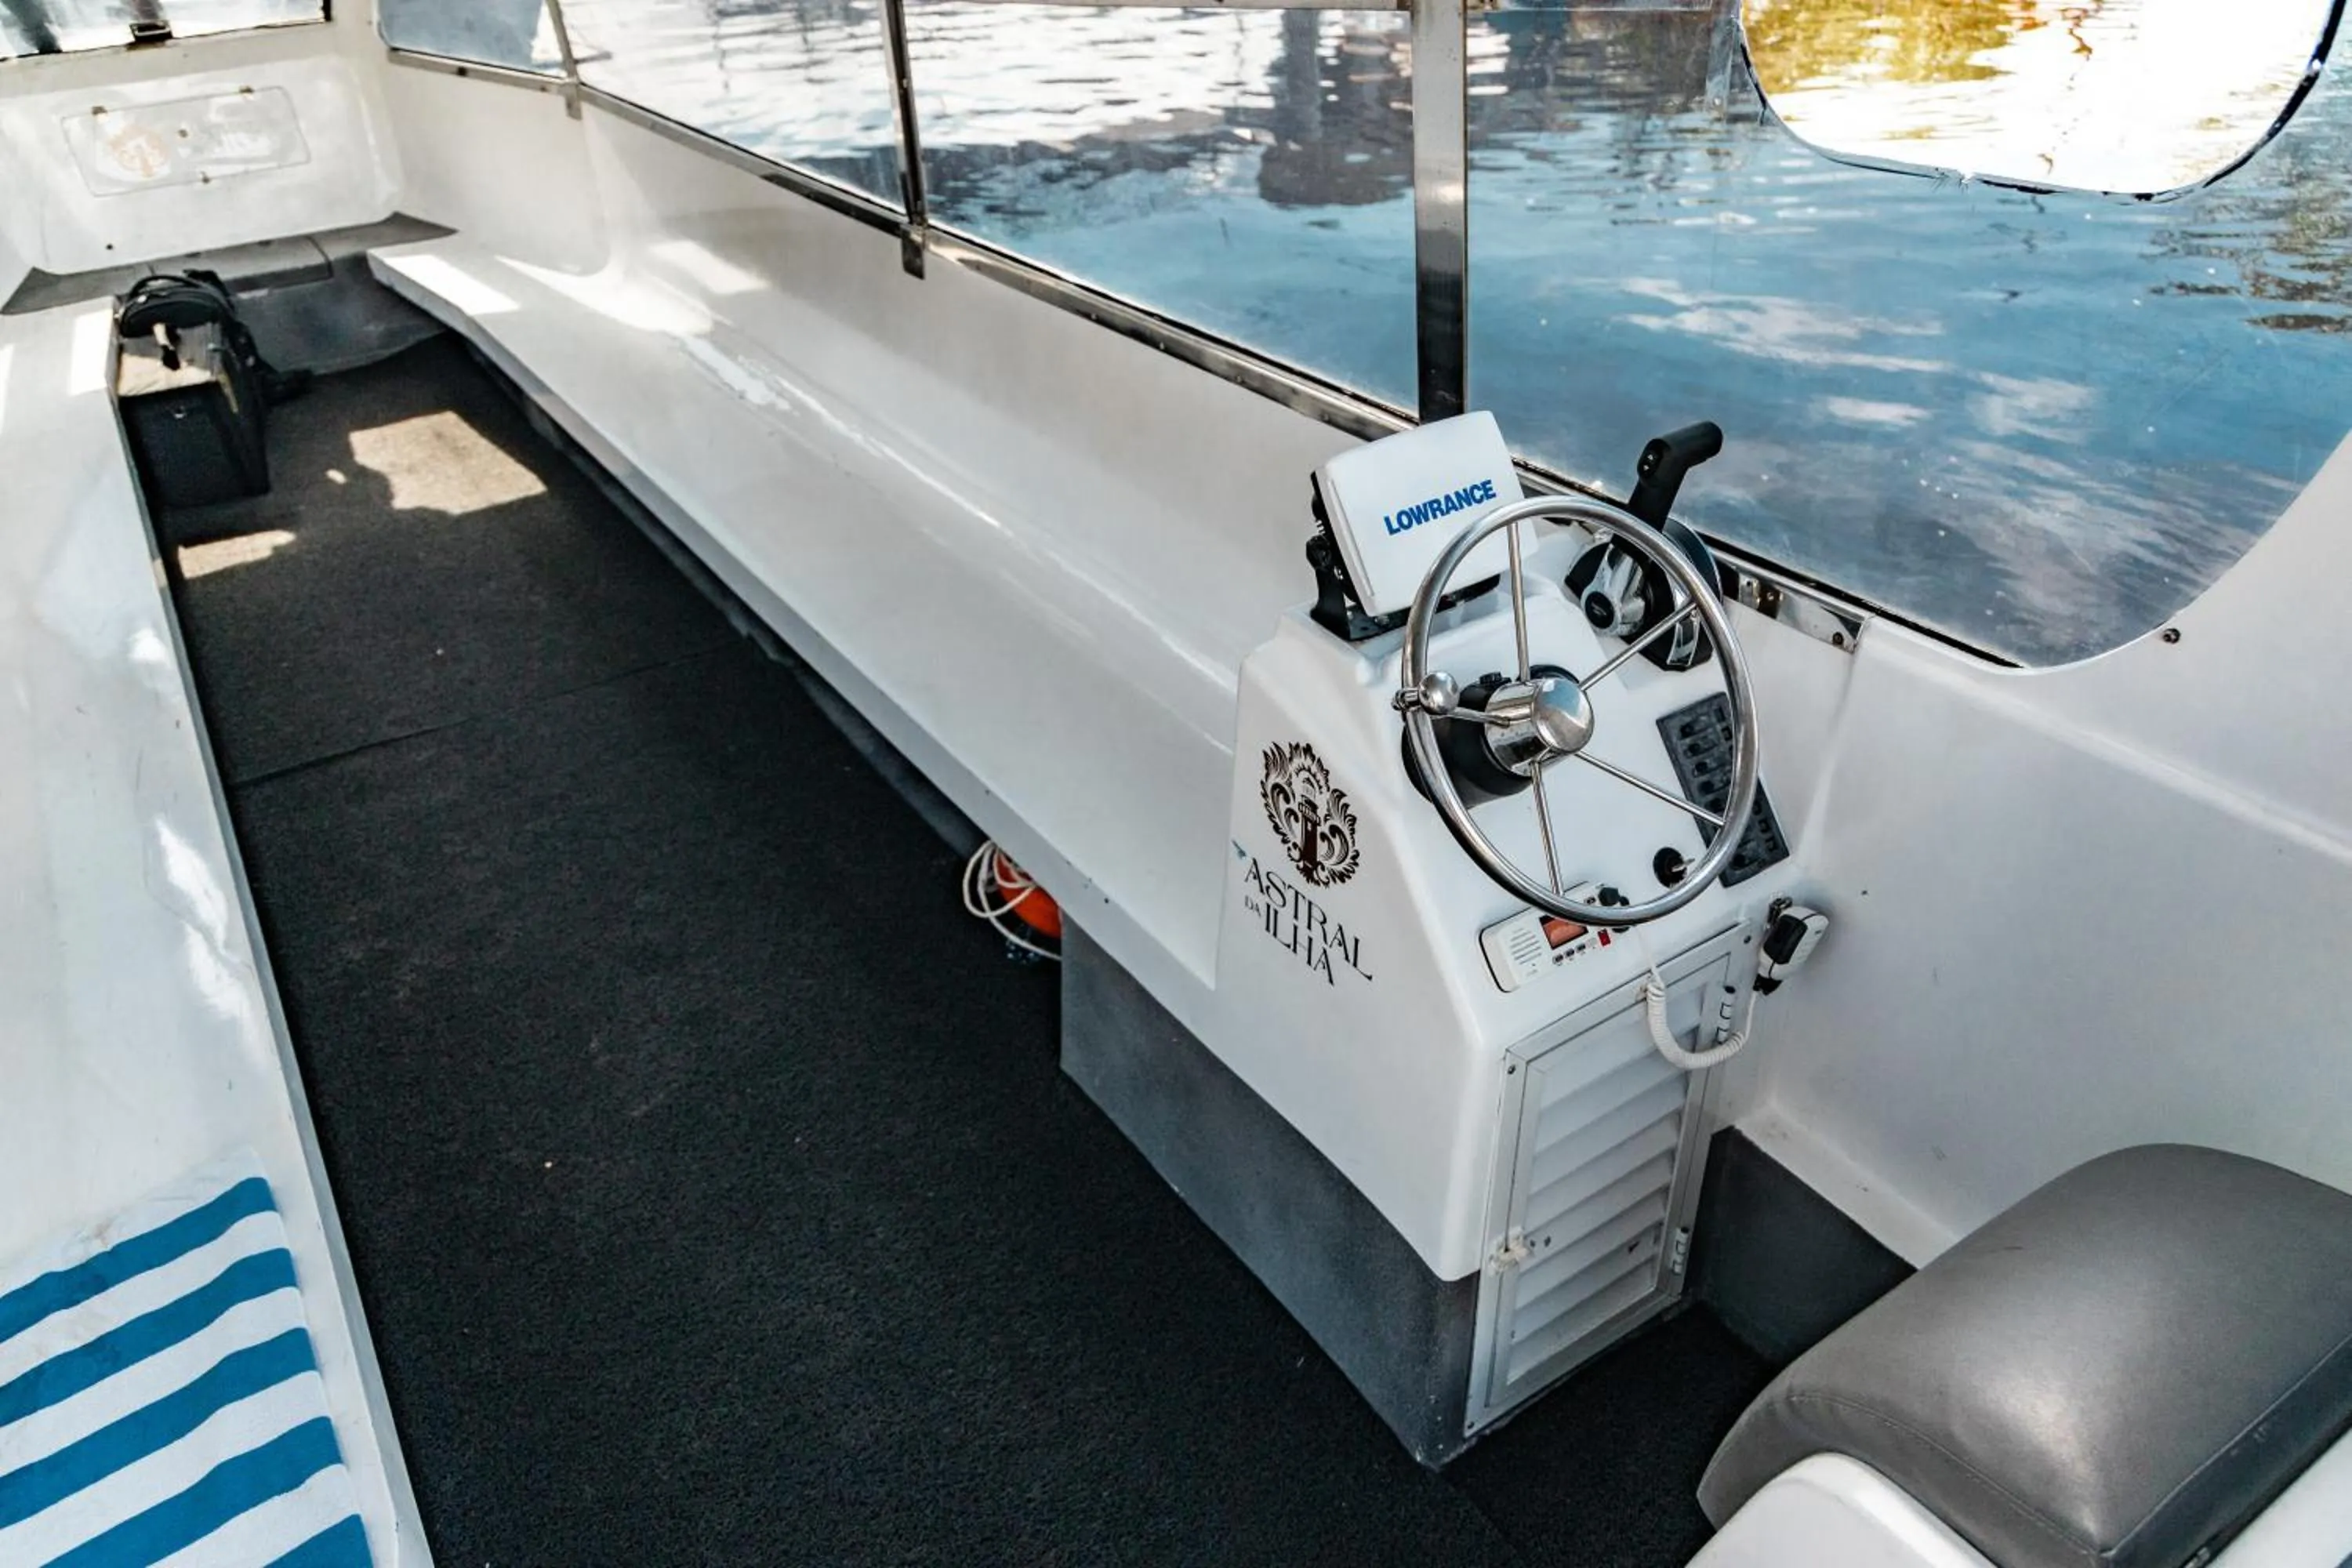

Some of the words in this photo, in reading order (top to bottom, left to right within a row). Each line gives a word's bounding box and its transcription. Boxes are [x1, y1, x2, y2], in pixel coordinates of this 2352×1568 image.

[1383, 480, 1497, 535] LOWRANCE
[1244, 857, 1373, 981] ASTRAL
[1265, 902, 1334, 986] ILHA
